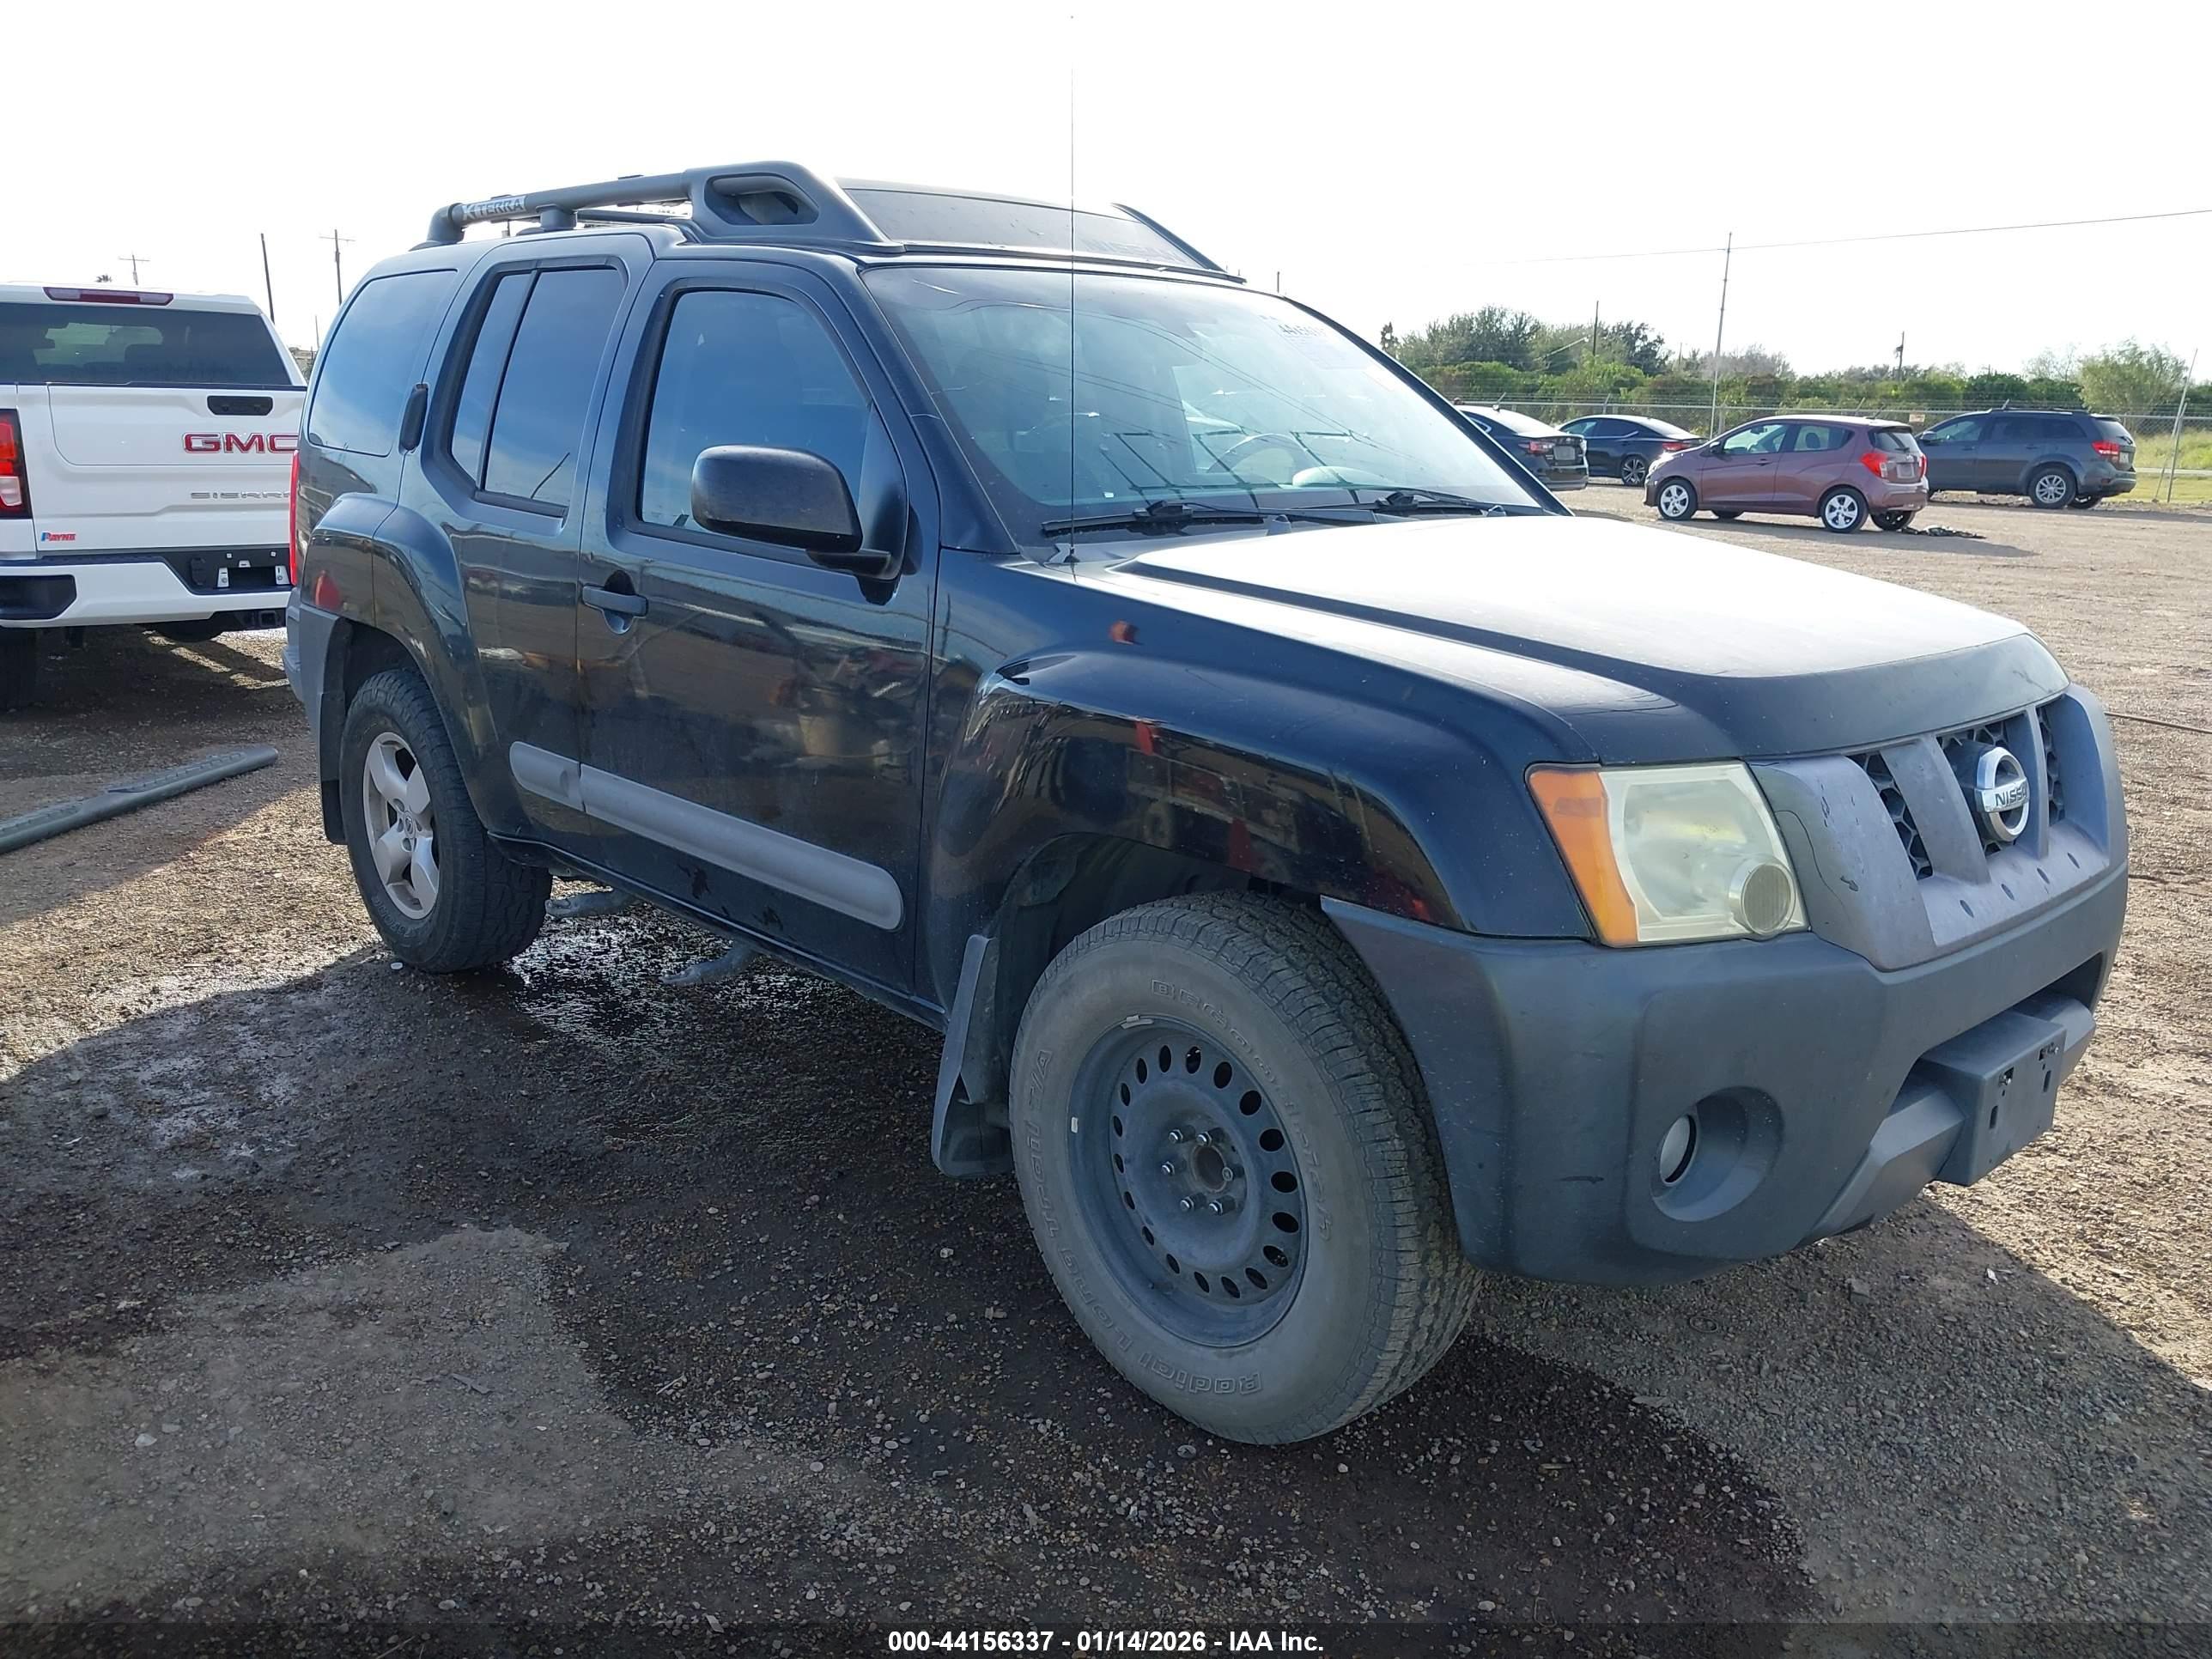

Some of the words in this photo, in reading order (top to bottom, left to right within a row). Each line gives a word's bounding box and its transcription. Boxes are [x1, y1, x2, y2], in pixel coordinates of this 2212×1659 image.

[462, 198, 524, 222] XTERRA
[183, 433, 298, 453] GMC
[1995, 784, 2027, 807] NISSA
[1030, 1049, 1053, 1112] T/A
[1024, 1120, 1060, 1238] Trail
[1059, 1247, 1133, 1352] Long
[1138, 1352, 1263, 1396] Radial
